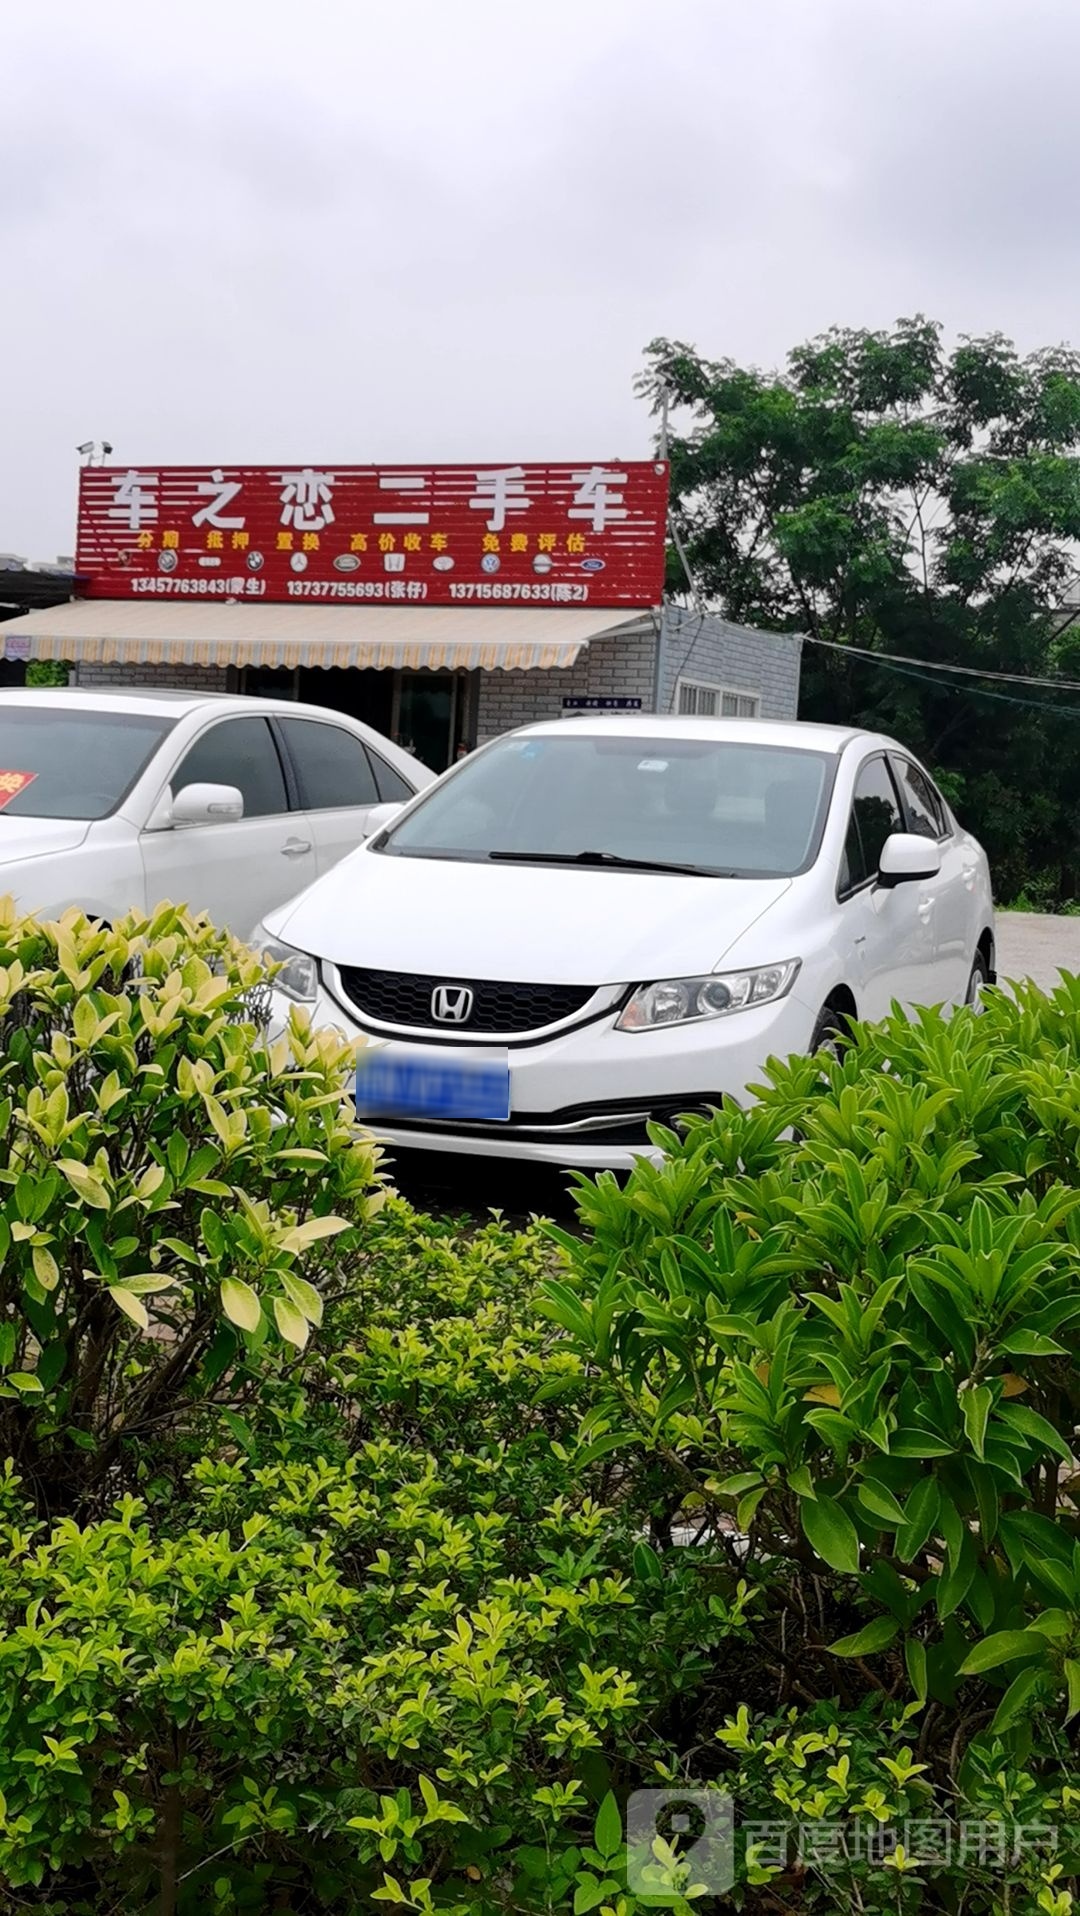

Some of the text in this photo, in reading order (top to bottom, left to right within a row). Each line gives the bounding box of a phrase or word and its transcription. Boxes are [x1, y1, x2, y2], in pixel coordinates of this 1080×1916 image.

[107, 466, 628, 532] 车之恋二手车
[137, 531, 586, 552] 分期 抵押 置换 高价收车 免费评估
